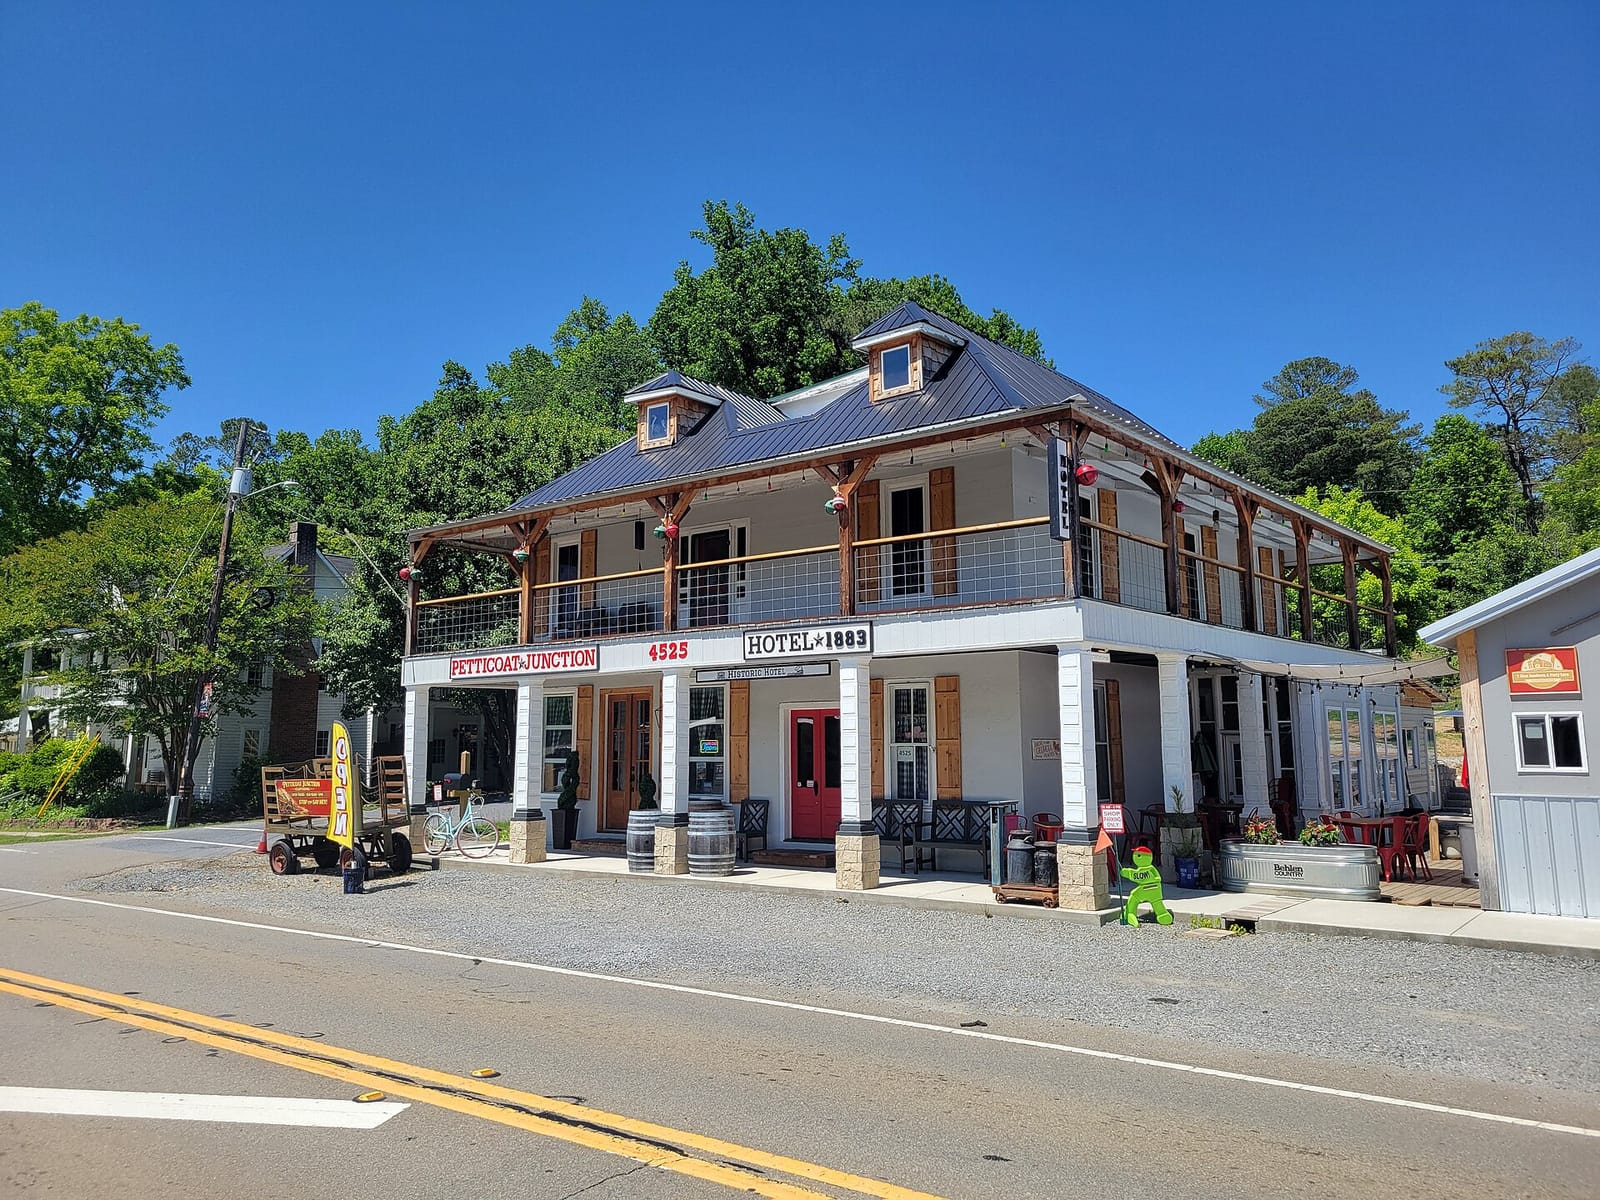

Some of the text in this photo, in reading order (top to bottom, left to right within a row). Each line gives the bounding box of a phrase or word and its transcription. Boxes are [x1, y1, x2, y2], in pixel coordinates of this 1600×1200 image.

[1060, 454, 1069, 529] HOTEL
[648, 641, 689, 661] 4525
[747, 629, 867, 655] HOTEL 1883
[451, 648, 596, 676] PETTICOAT JUNCTION
[727, 667, 786, 679] HISTORIC HOTEL
[1273, 863, 1304, 872] Behlen
